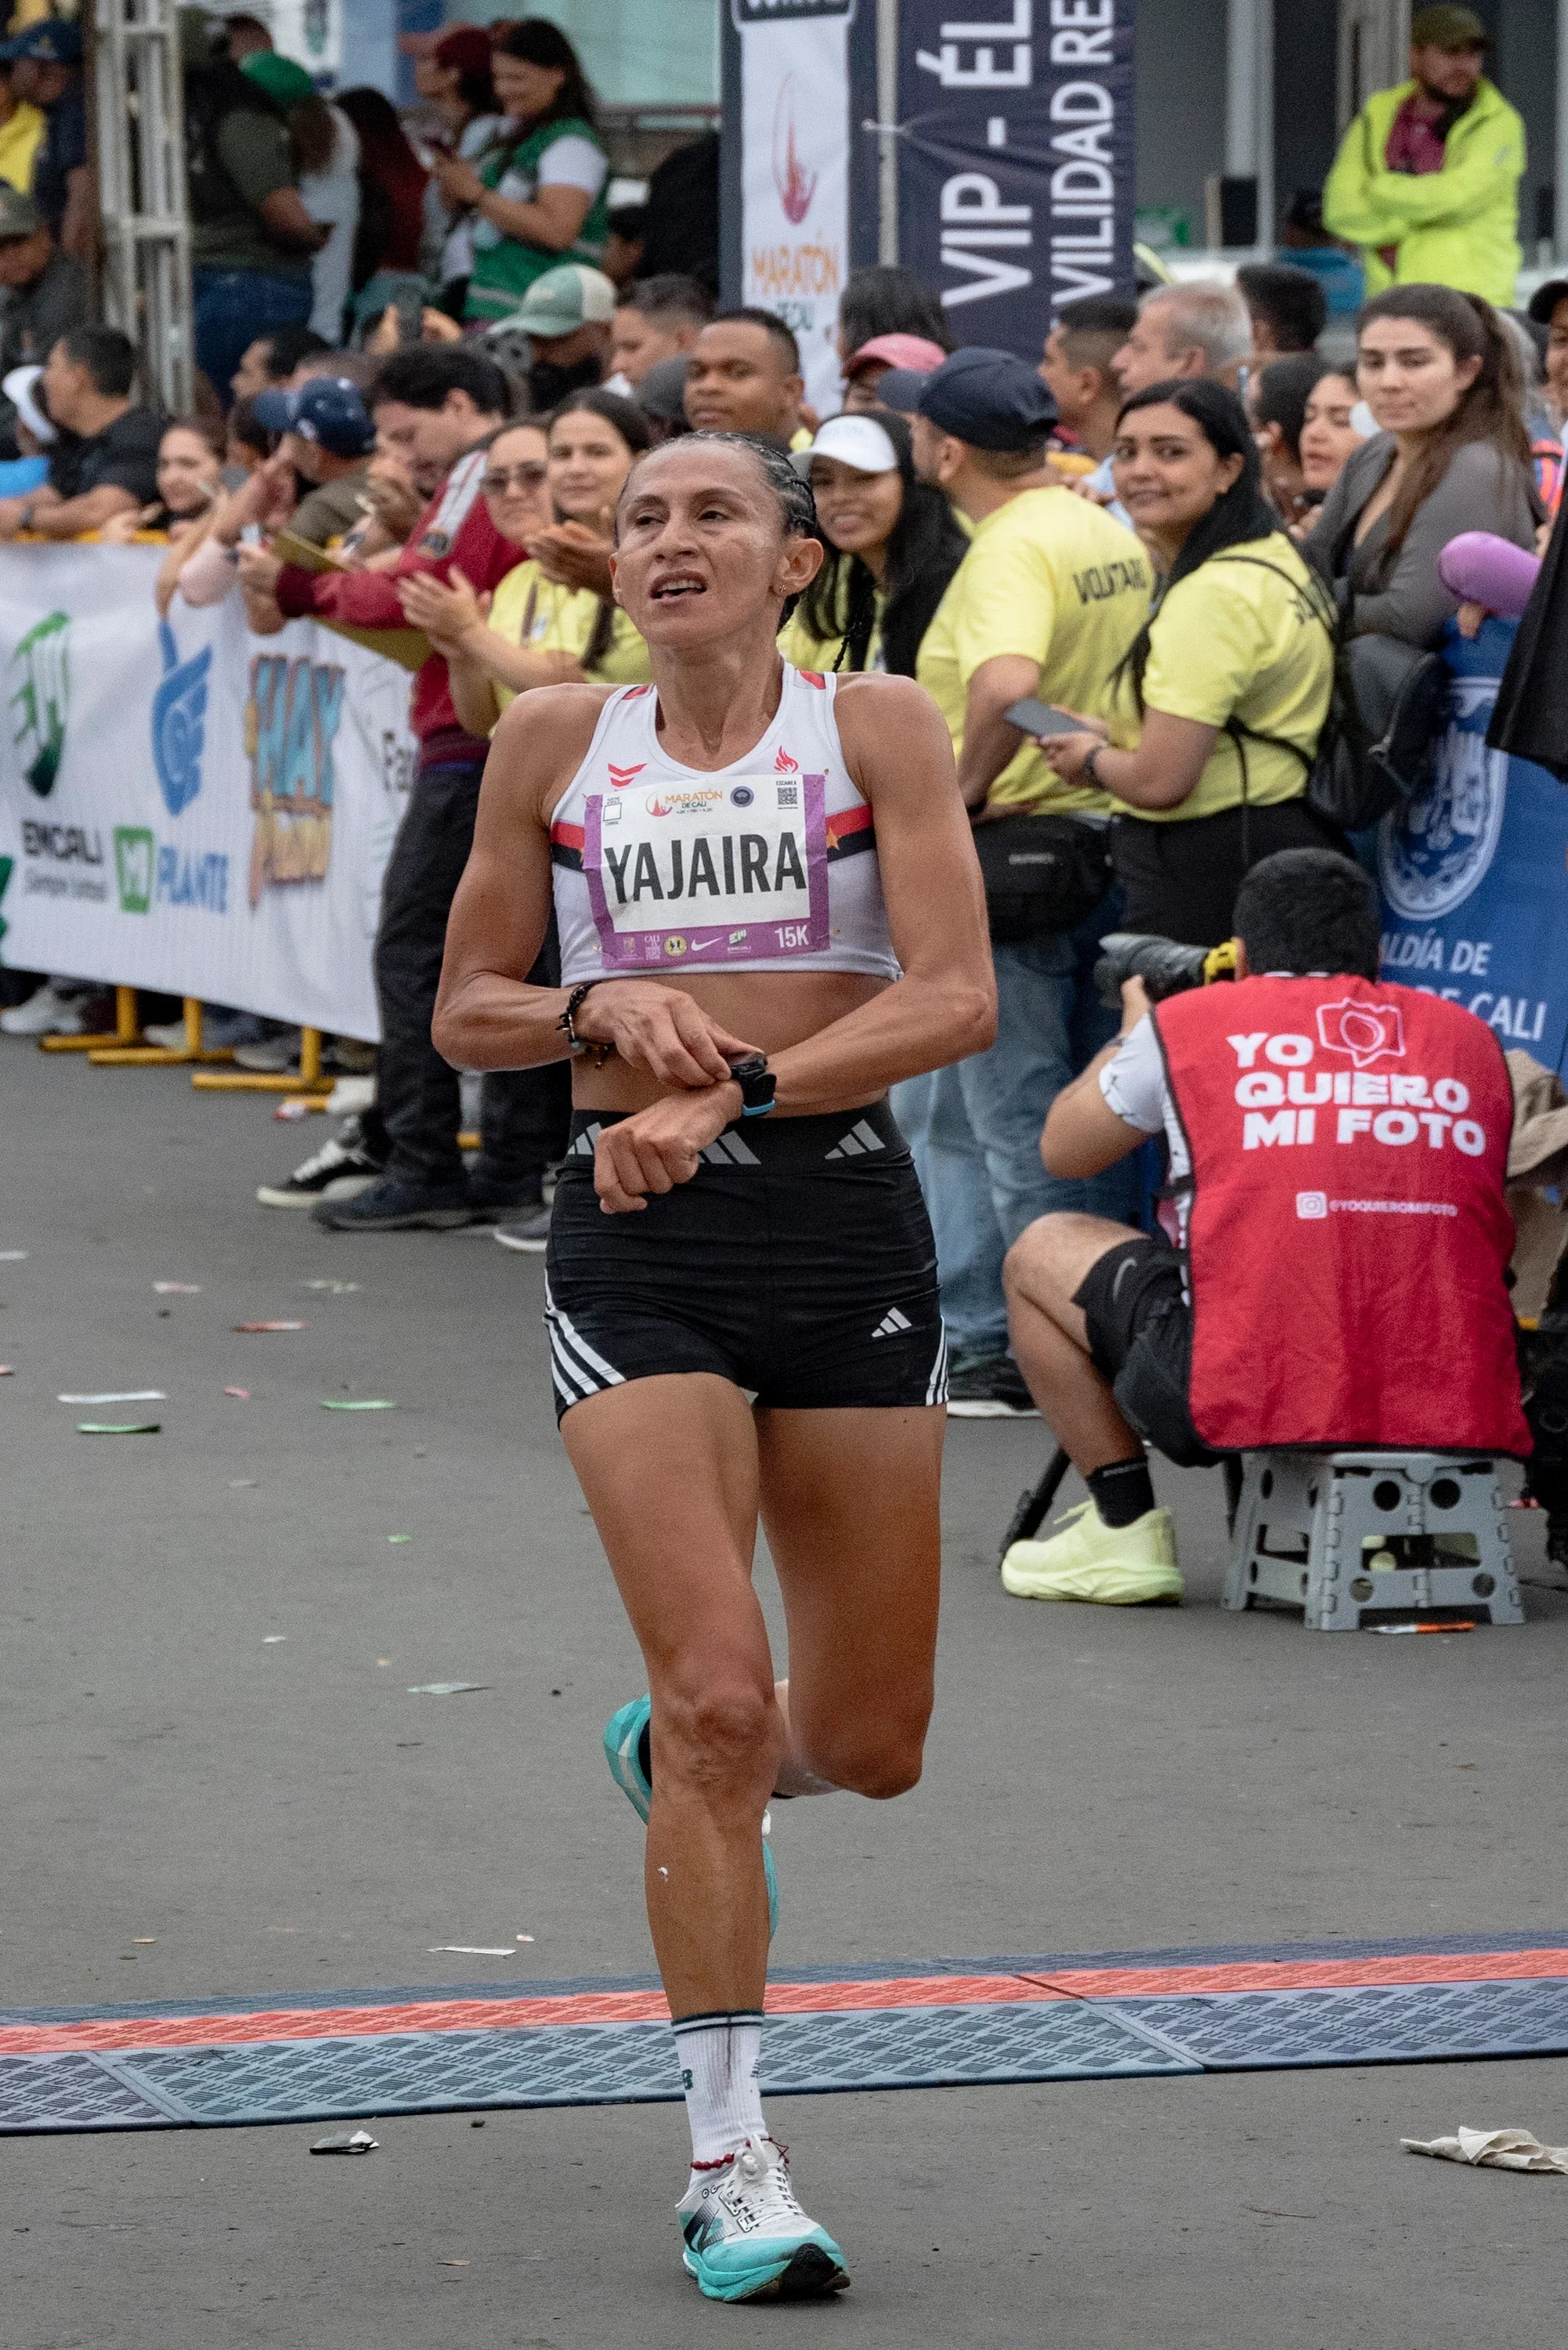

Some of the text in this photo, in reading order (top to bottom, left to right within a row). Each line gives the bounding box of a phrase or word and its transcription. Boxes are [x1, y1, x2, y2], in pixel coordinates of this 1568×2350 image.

[916, 0, 1031, 86] ÉL
[1051, 81, 1114, 304] VILIDAD
[941, 172, 1031, 306] VIP
[666, 788, 723, 803] MARATÓN
[603, 831, 807, 905] YAJAIRA
[774, 925, 809, 949] 15K
[1450, 940, 1492, 977] DE
[1468, 991, 1547, 1042] CALI
[1226, 1032, 1314, 1068] YO
[1234, 1071, 1470, 1113] QUIERO
[1242, 1108, 1487, 1157] MI FOTO
